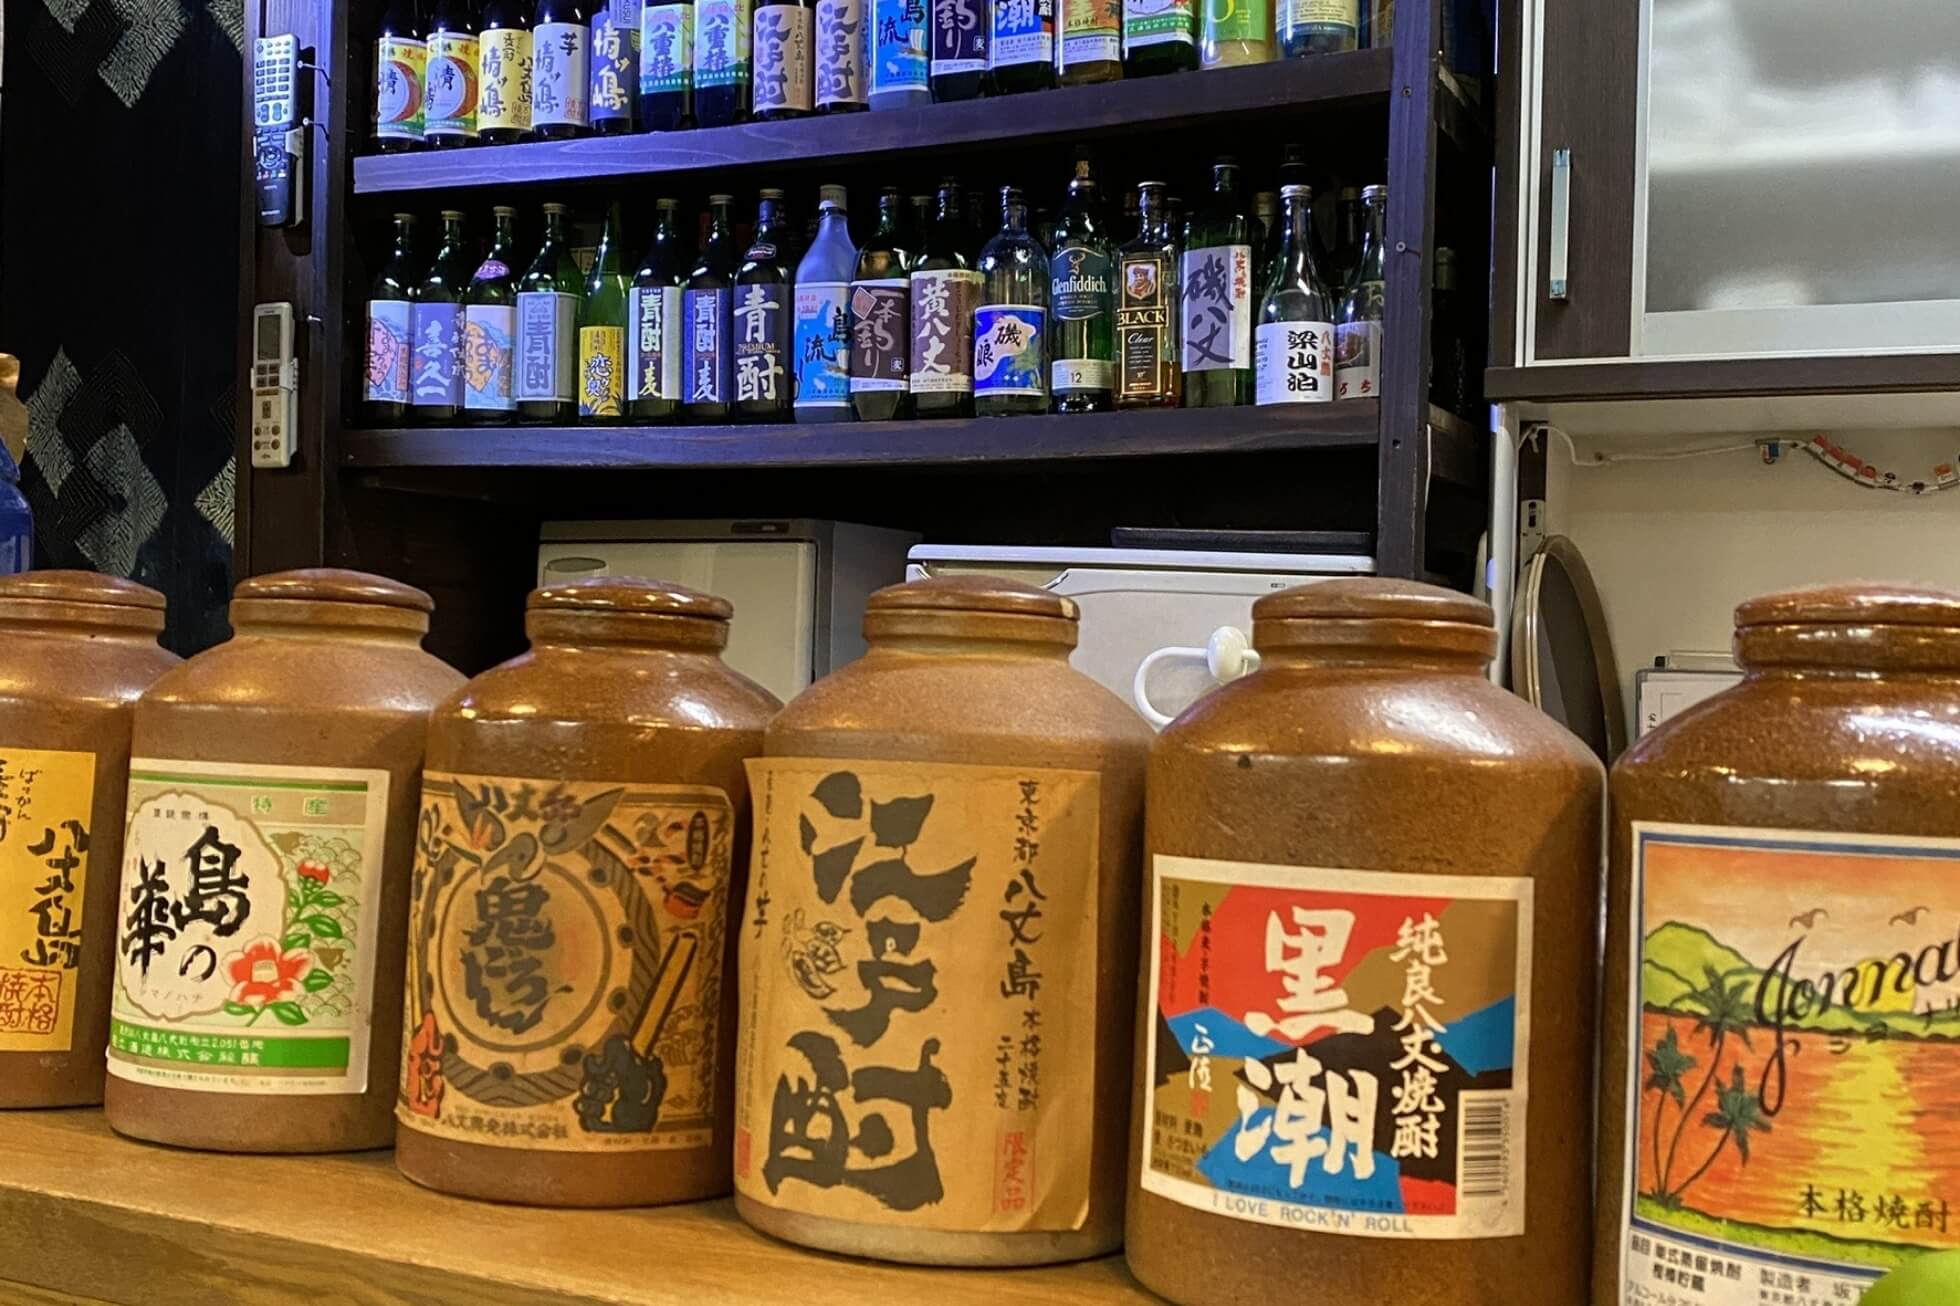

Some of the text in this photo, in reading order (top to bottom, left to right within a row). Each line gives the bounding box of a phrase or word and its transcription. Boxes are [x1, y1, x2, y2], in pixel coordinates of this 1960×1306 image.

[560, 32, 578, 56] 芋
[1052, 277, 1107, 295] Glenfiddich
[640, 294, 662, 353] 青酎
[695, 295, 716, 353] 青酎
[734, 284, 780, 344] 青
[917, 276, 951, 374] 黄八丈
[1119, 311, 1166, 326] BLACK
[525, 320, 553, 390] 青酎
[638, 361, 663, 398] 麦
[738, 355, 785, 401] 酎
[1070, 372, 1082, 384] 12
[1287, 330, 1319, 392] 梁山泊
[692, 361, 719, 403] 麦
[999, 780, 1047, 1000] 東京都八丈島
[1234, 905, 1376, 1189] 黒潮
[1389, 911, 1450, 1160] 純良八丈焼酎
[1224, 1196, 1270, 1218] LOVE
[1364, 1215, 1415, 1233] ROLL
[1800, 1184, 1951, 1233] 本格焼酎
[1760, 1267, 1812, 1294] 製造者
